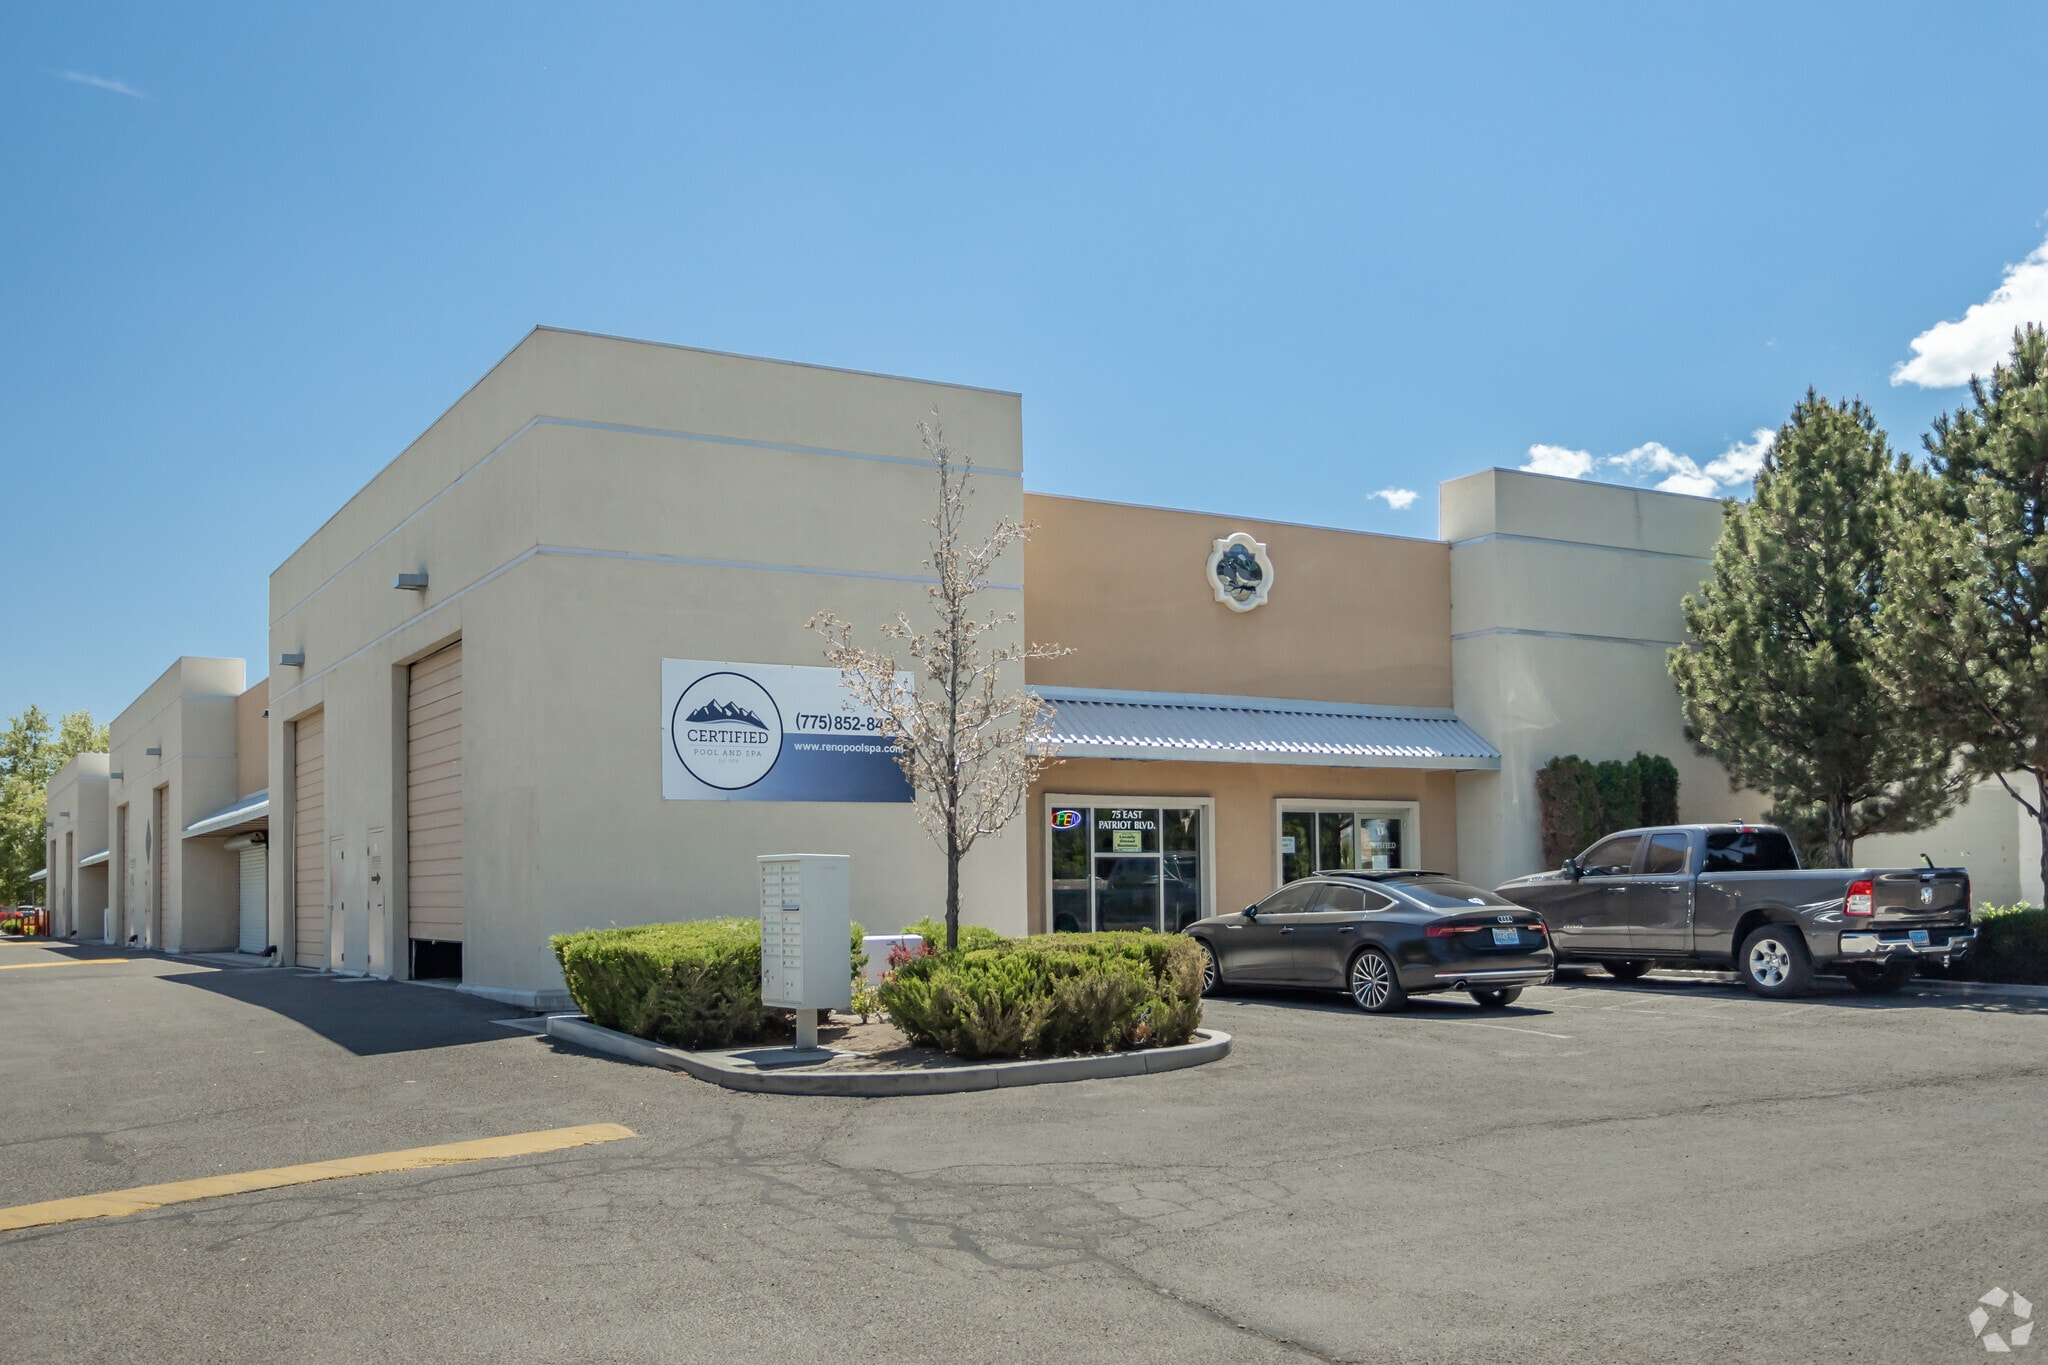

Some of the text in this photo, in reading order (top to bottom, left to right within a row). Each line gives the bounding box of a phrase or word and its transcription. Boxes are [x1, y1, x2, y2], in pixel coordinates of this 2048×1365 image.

[687, 729, 769, 744] CERTIFIED
[1051, 812, 1079, 826] OPEN
[1111, 810, 1143, 819] 75 EAST
[1098, 820, 1156, 830] PATRIOT BLVD.
